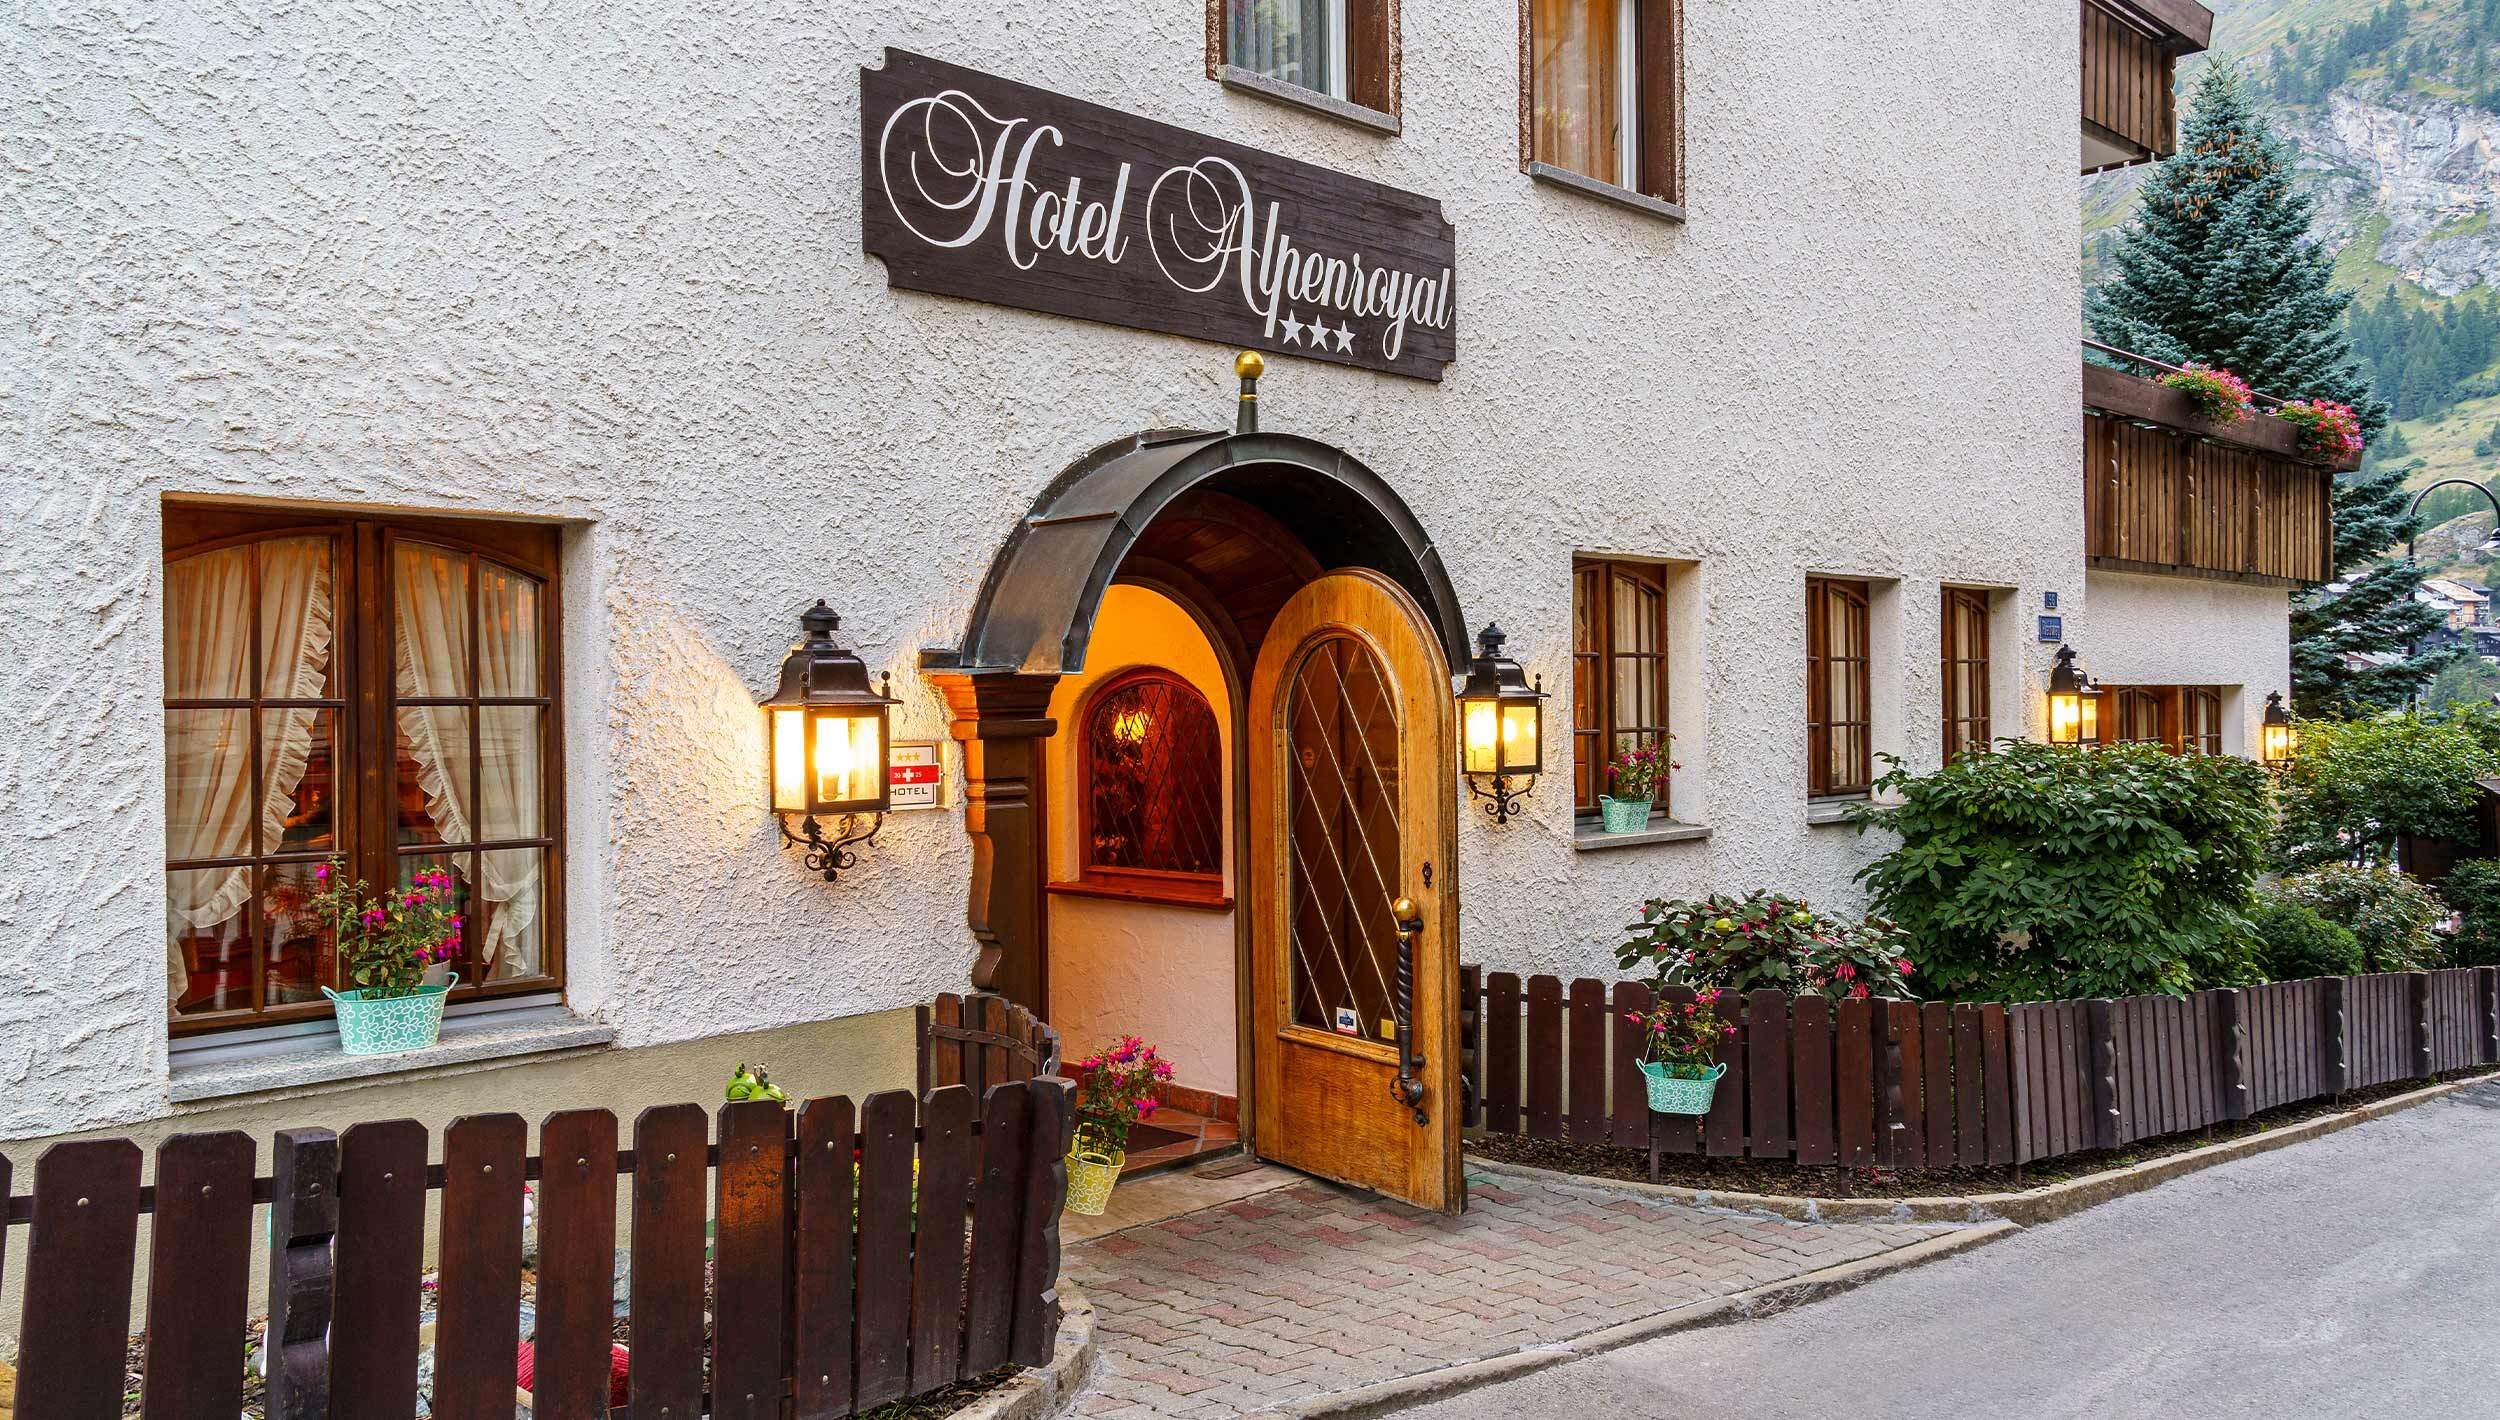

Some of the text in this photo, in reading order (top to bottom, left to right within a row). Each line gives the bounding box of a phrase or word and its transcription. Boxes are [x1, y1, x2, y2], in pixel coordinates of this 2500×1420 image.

[880, 89, 1453, 361] Hotel Alpenroyal
[890, 787, 928, 796] HOTEL
